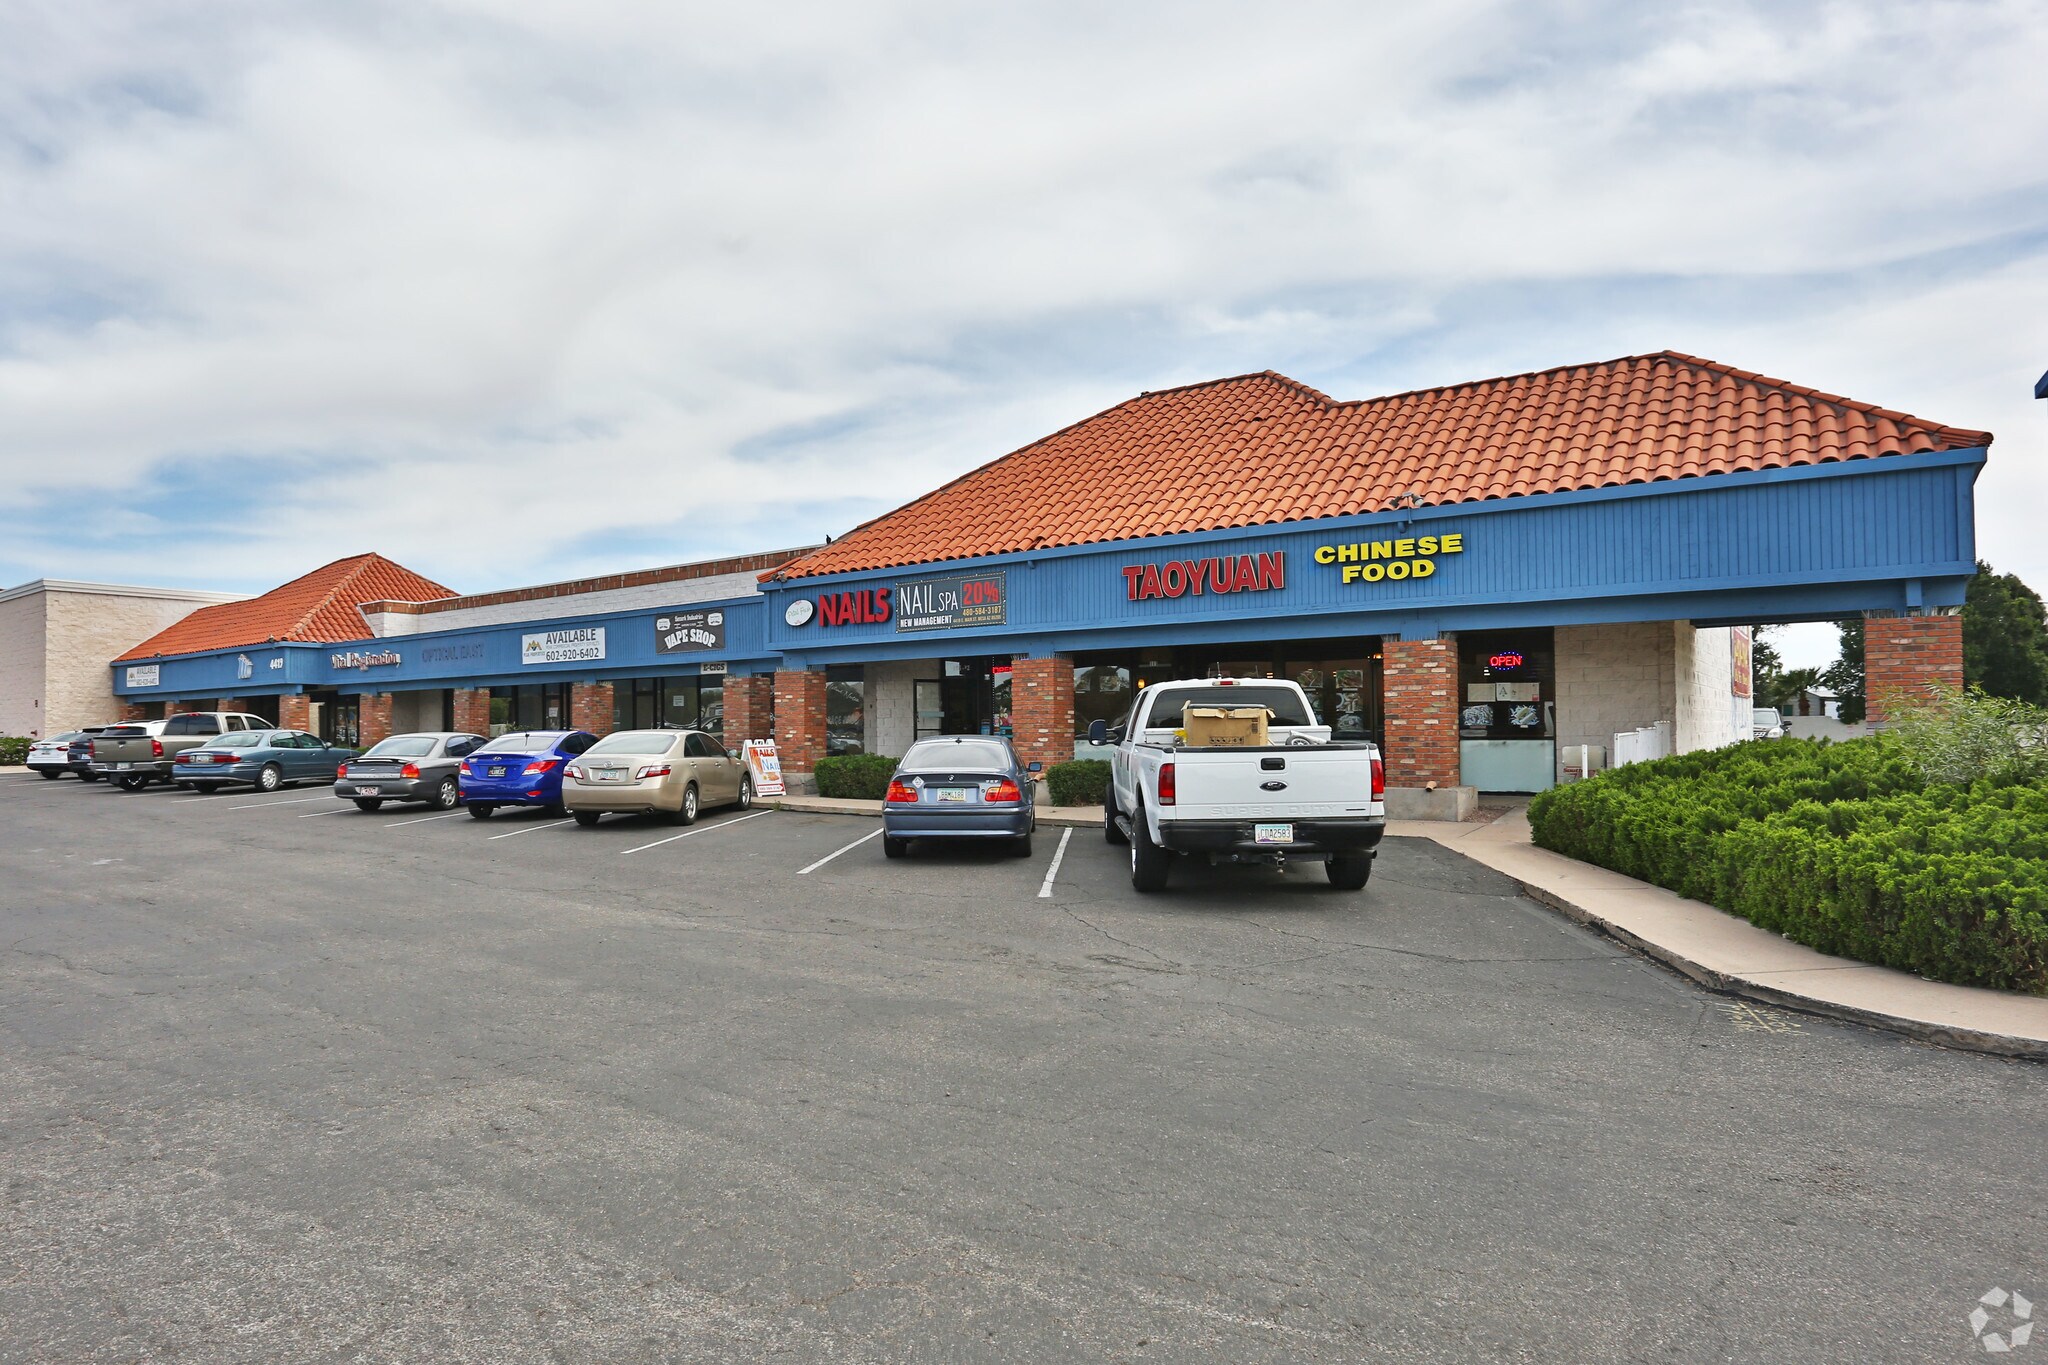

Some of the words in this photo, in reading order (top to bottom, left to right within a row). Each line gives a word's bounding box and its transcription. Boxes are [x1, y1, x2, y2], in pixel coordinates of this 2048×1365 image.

[1314, 533, 1463, 564] CHINESE
[1122, 550, 1284, 600] TAOYUAN
[1342, 559, 1436, 584] FOOD
[900, 584, 937, 616] NAIL
[938, 590, 959, 612] SPA
[962, 580, 999, 605] 20%
[818, 587, 891, 627] NAILS
[900, 617, 913, 628] NEW
[913, 615, 953, 626] MANAGEMENT
[545, 628, 596, 645] AVAILABLE
[664, 629, 689, 649] VAPE
[690, 628, 716, 647] SHOP
[545, 647, 600, 661] 602-920-6402
[1490, 655, 1522, 667] OPEN
[703, 663, 725, 671] E-CIGS
[1210, 805, 1274, 816] SUPER
[1287, 804, 1337, 815] DUTY
